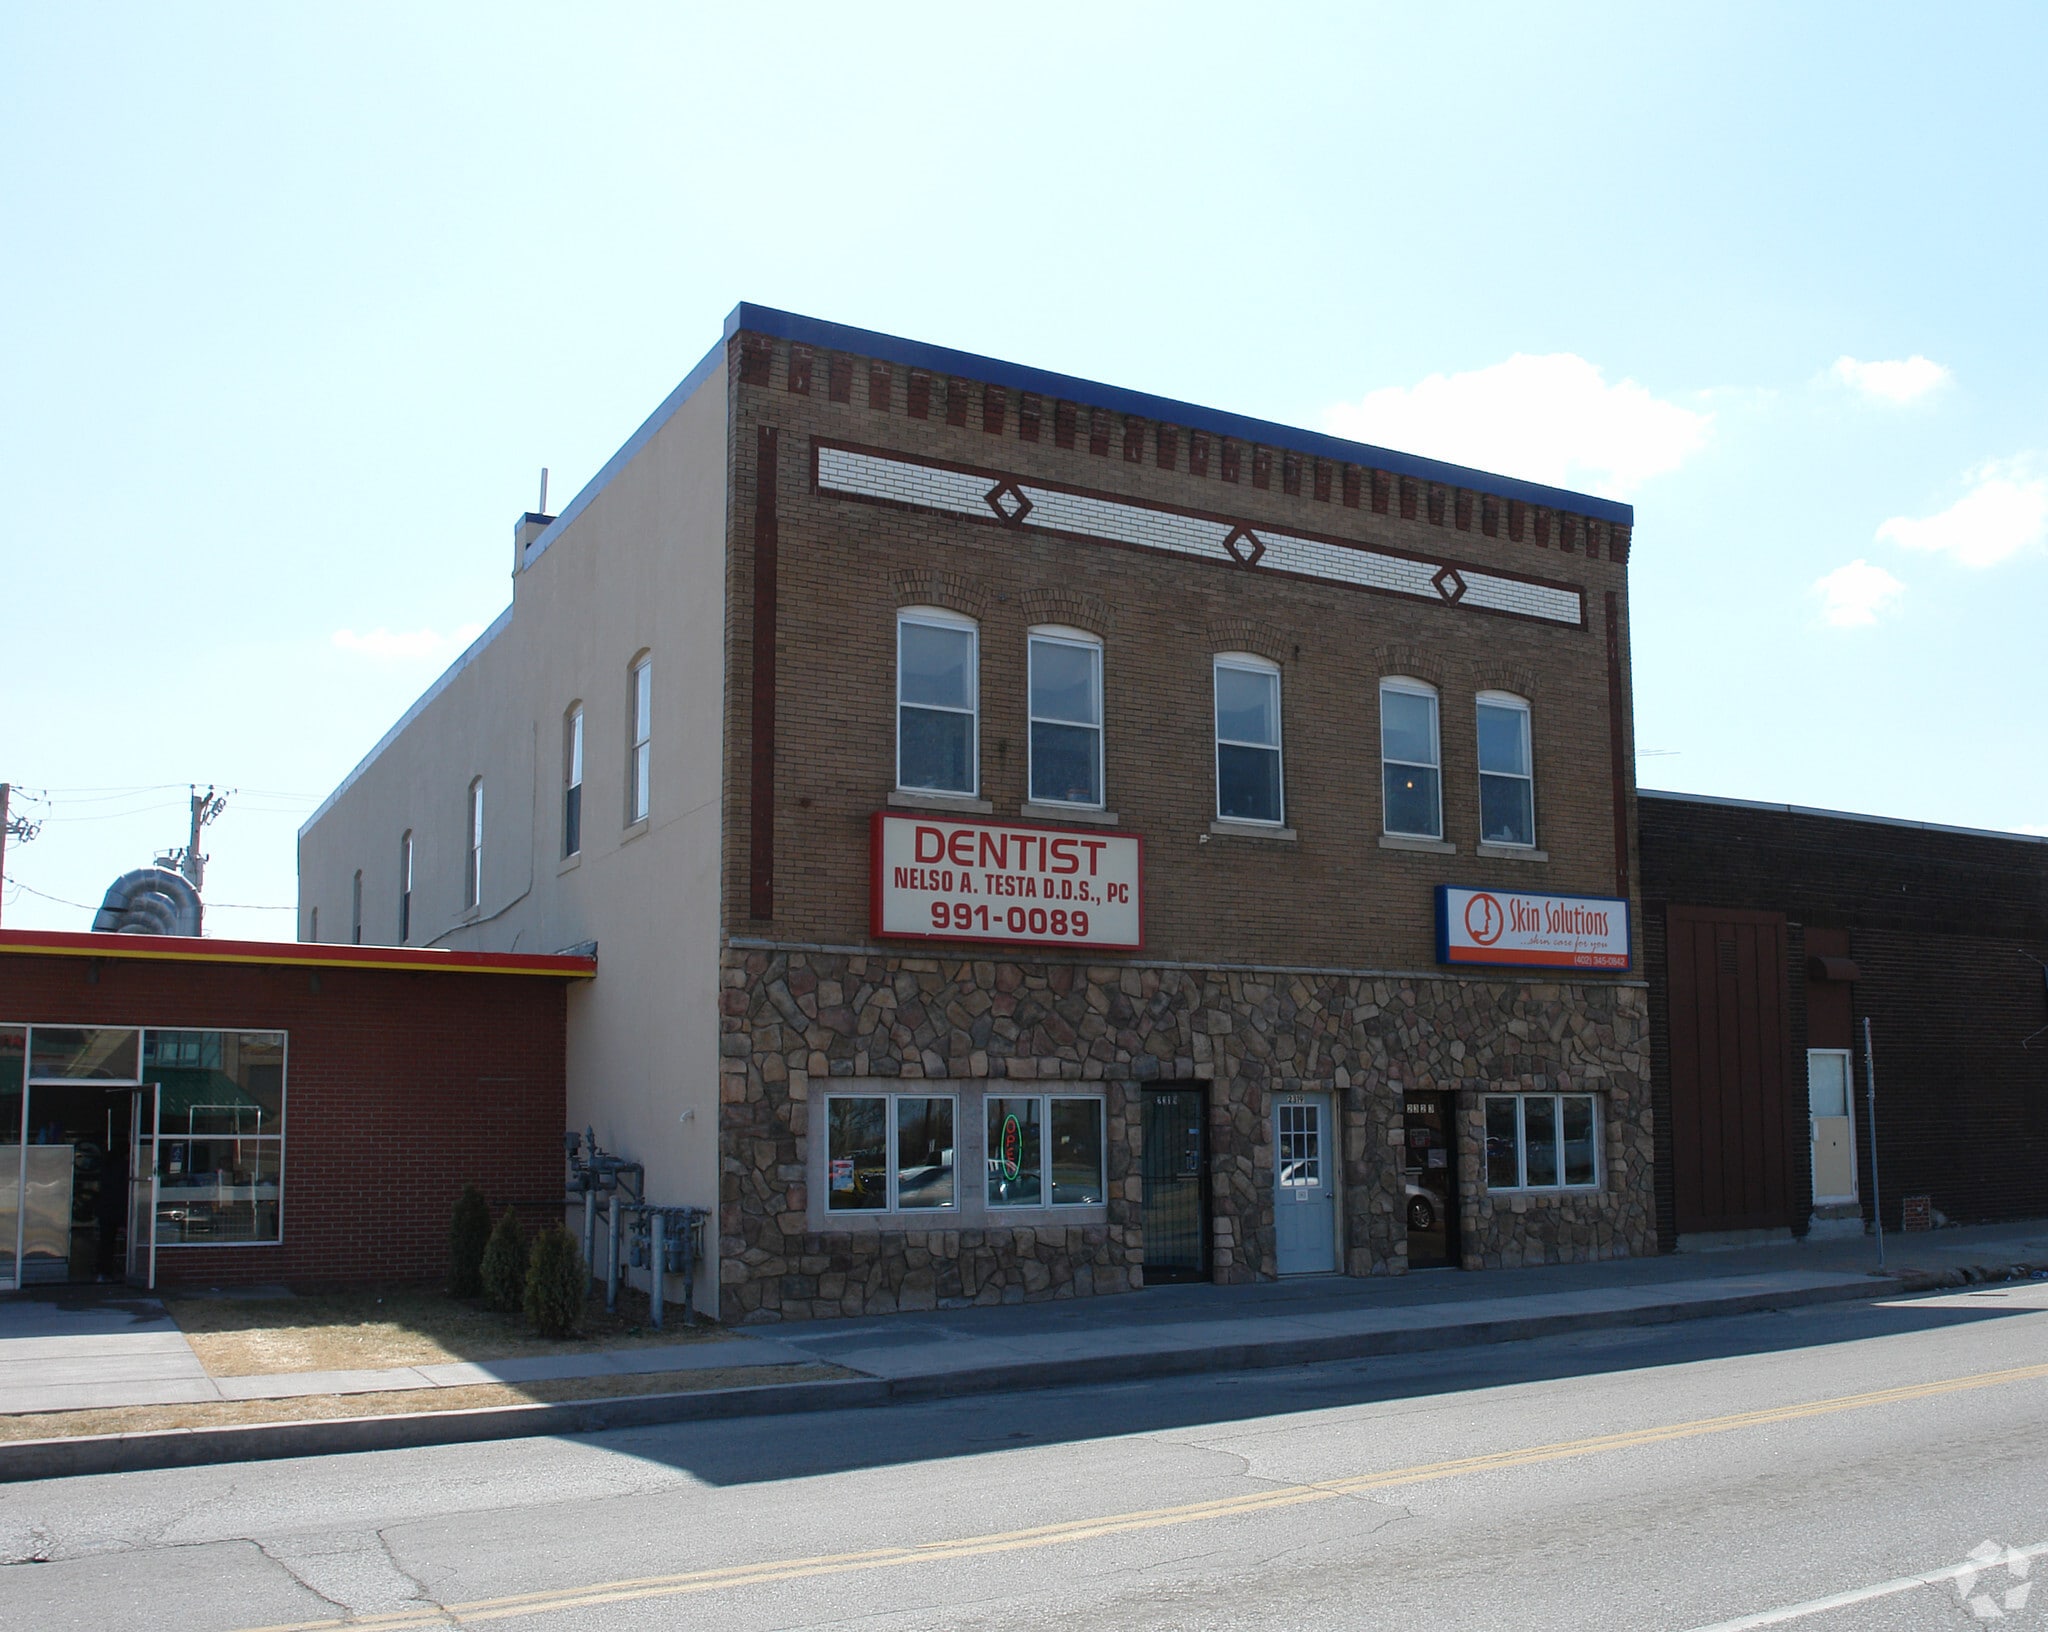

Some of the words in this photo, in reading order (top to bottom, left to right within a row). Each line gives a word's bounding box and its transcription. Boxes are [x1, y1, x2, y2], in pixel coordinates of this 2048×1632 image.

[915, 825, 1107, 876] DENTIST
[894, 866, 953, 892] NELSO
[960, 872, 978, 894] A.
[985, 873, 1037, 898] TESTA
[1043, 878, 1101, 906] D.D.S.,
[1107, 882, 1129, 904] PC
[931, 901, 1088, 937] 991-0089
[1510, 898, 1540, 933] Skin
[1545, 901, 1608, 936] Solutions
[1574, 936, 1588, 953] for
[1590, 942, 1608, 953] you
